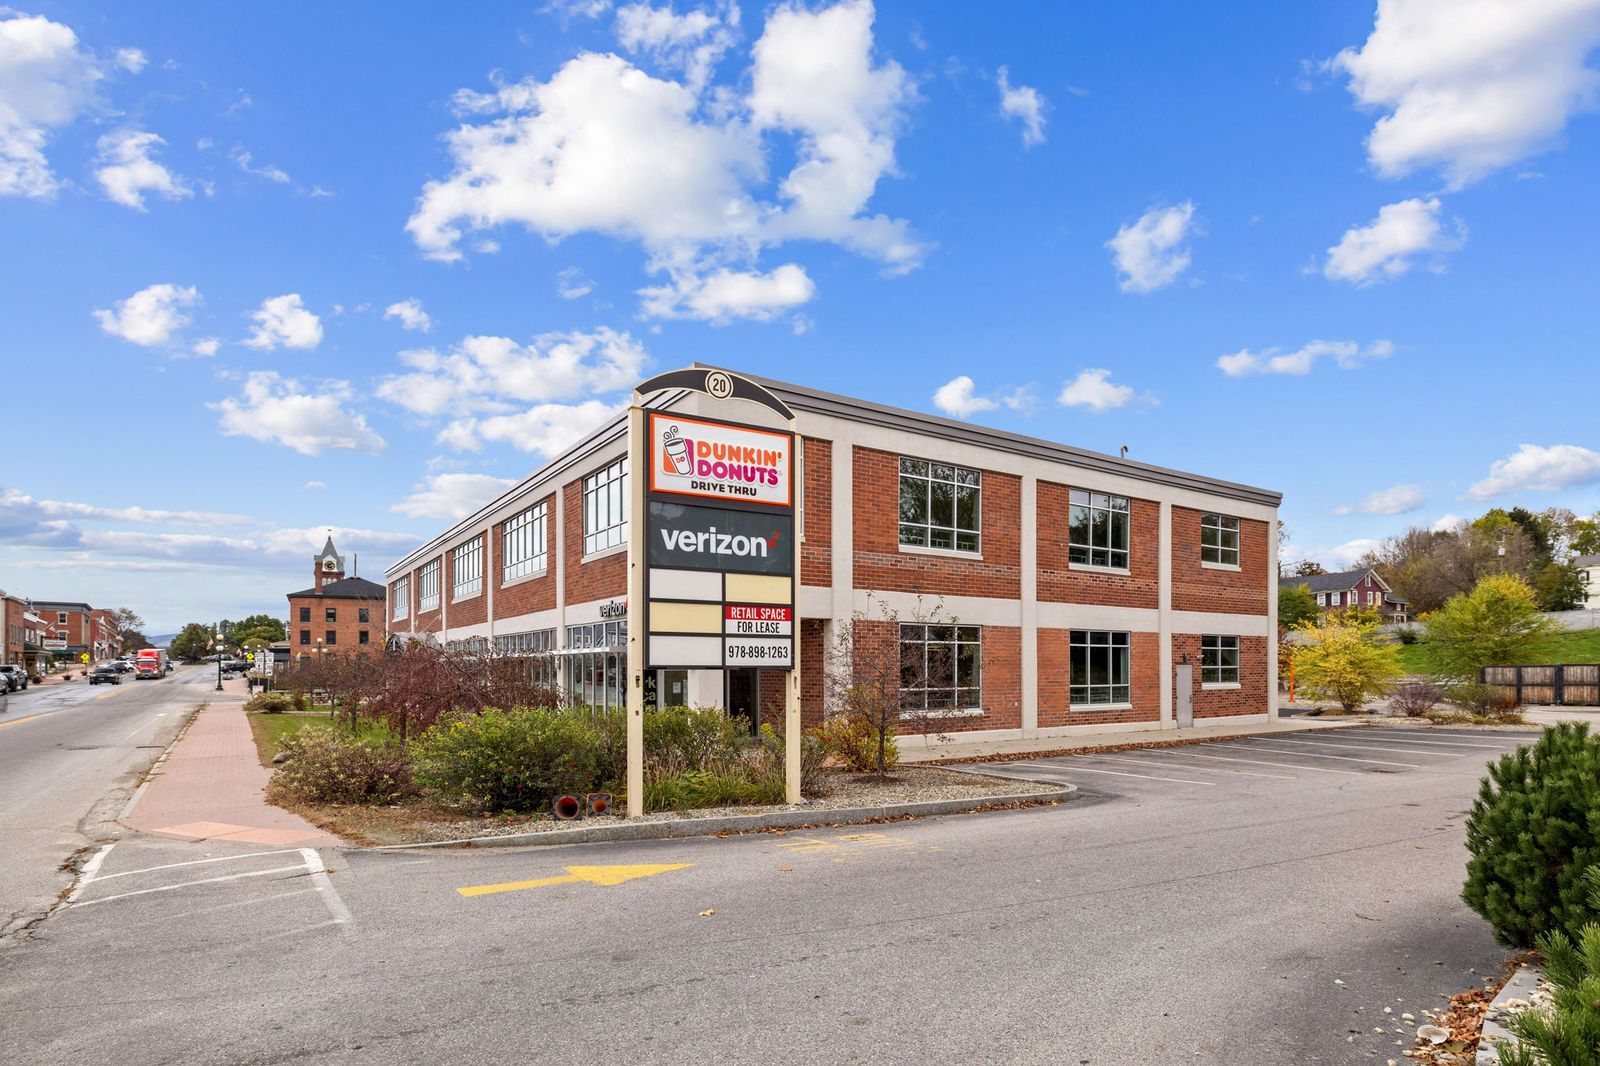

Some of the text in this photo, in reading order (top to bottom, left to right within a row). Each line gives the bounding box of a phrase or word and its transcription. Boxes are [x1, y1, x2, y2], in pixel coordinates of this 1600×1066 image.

[713, 378, 726, 393] 20
[697, 441, 782, 467] DUNKIN'
[697, 459, 778, 486] DONUTS
[691, 480, 757, 496] DRIVE THRU
[660, 526, 767, 557] verizon
[600, 600, 626, 617] verizon
[731, 606, 786, 620] RETAIL SPACE
[737, 621, 780, 634] FOR LEASE
[728, 646, 788, 659] 978-898-1263
